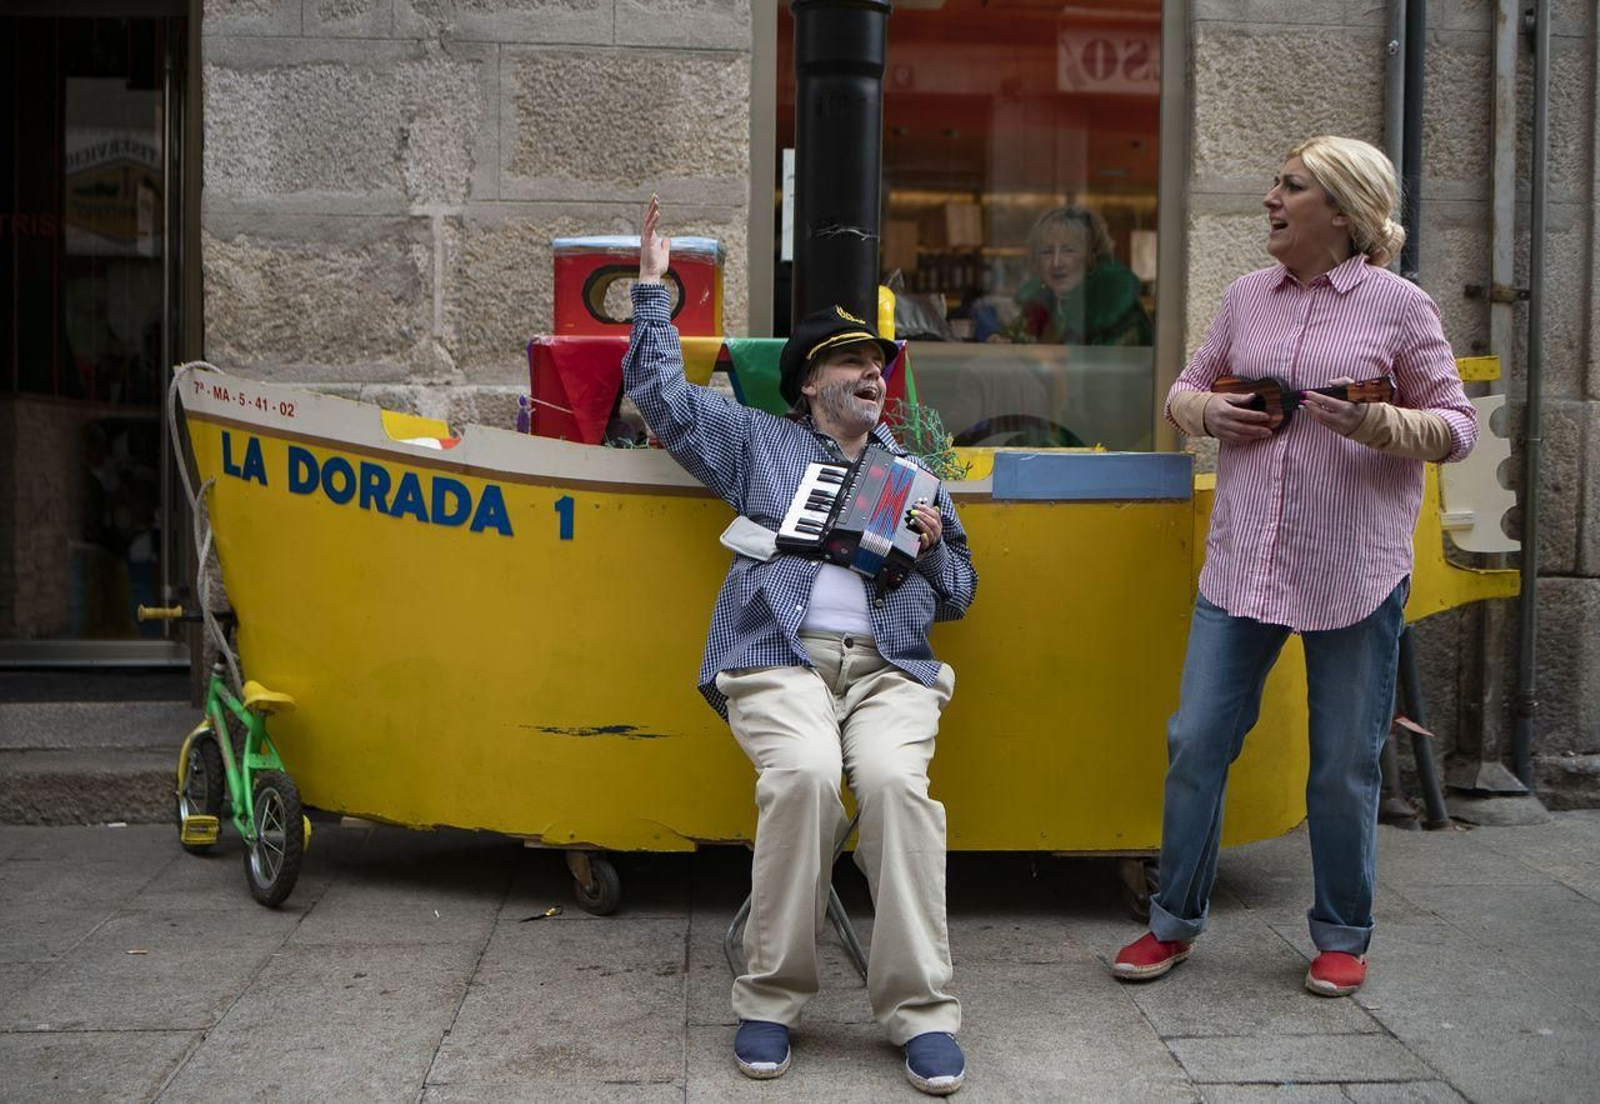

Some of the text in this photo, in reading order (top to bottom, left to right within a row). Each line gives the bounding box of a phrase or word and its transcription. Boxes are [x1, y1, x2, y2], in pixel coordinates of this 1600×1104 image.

[221, 430, 574, 540] LA DORADA 1
